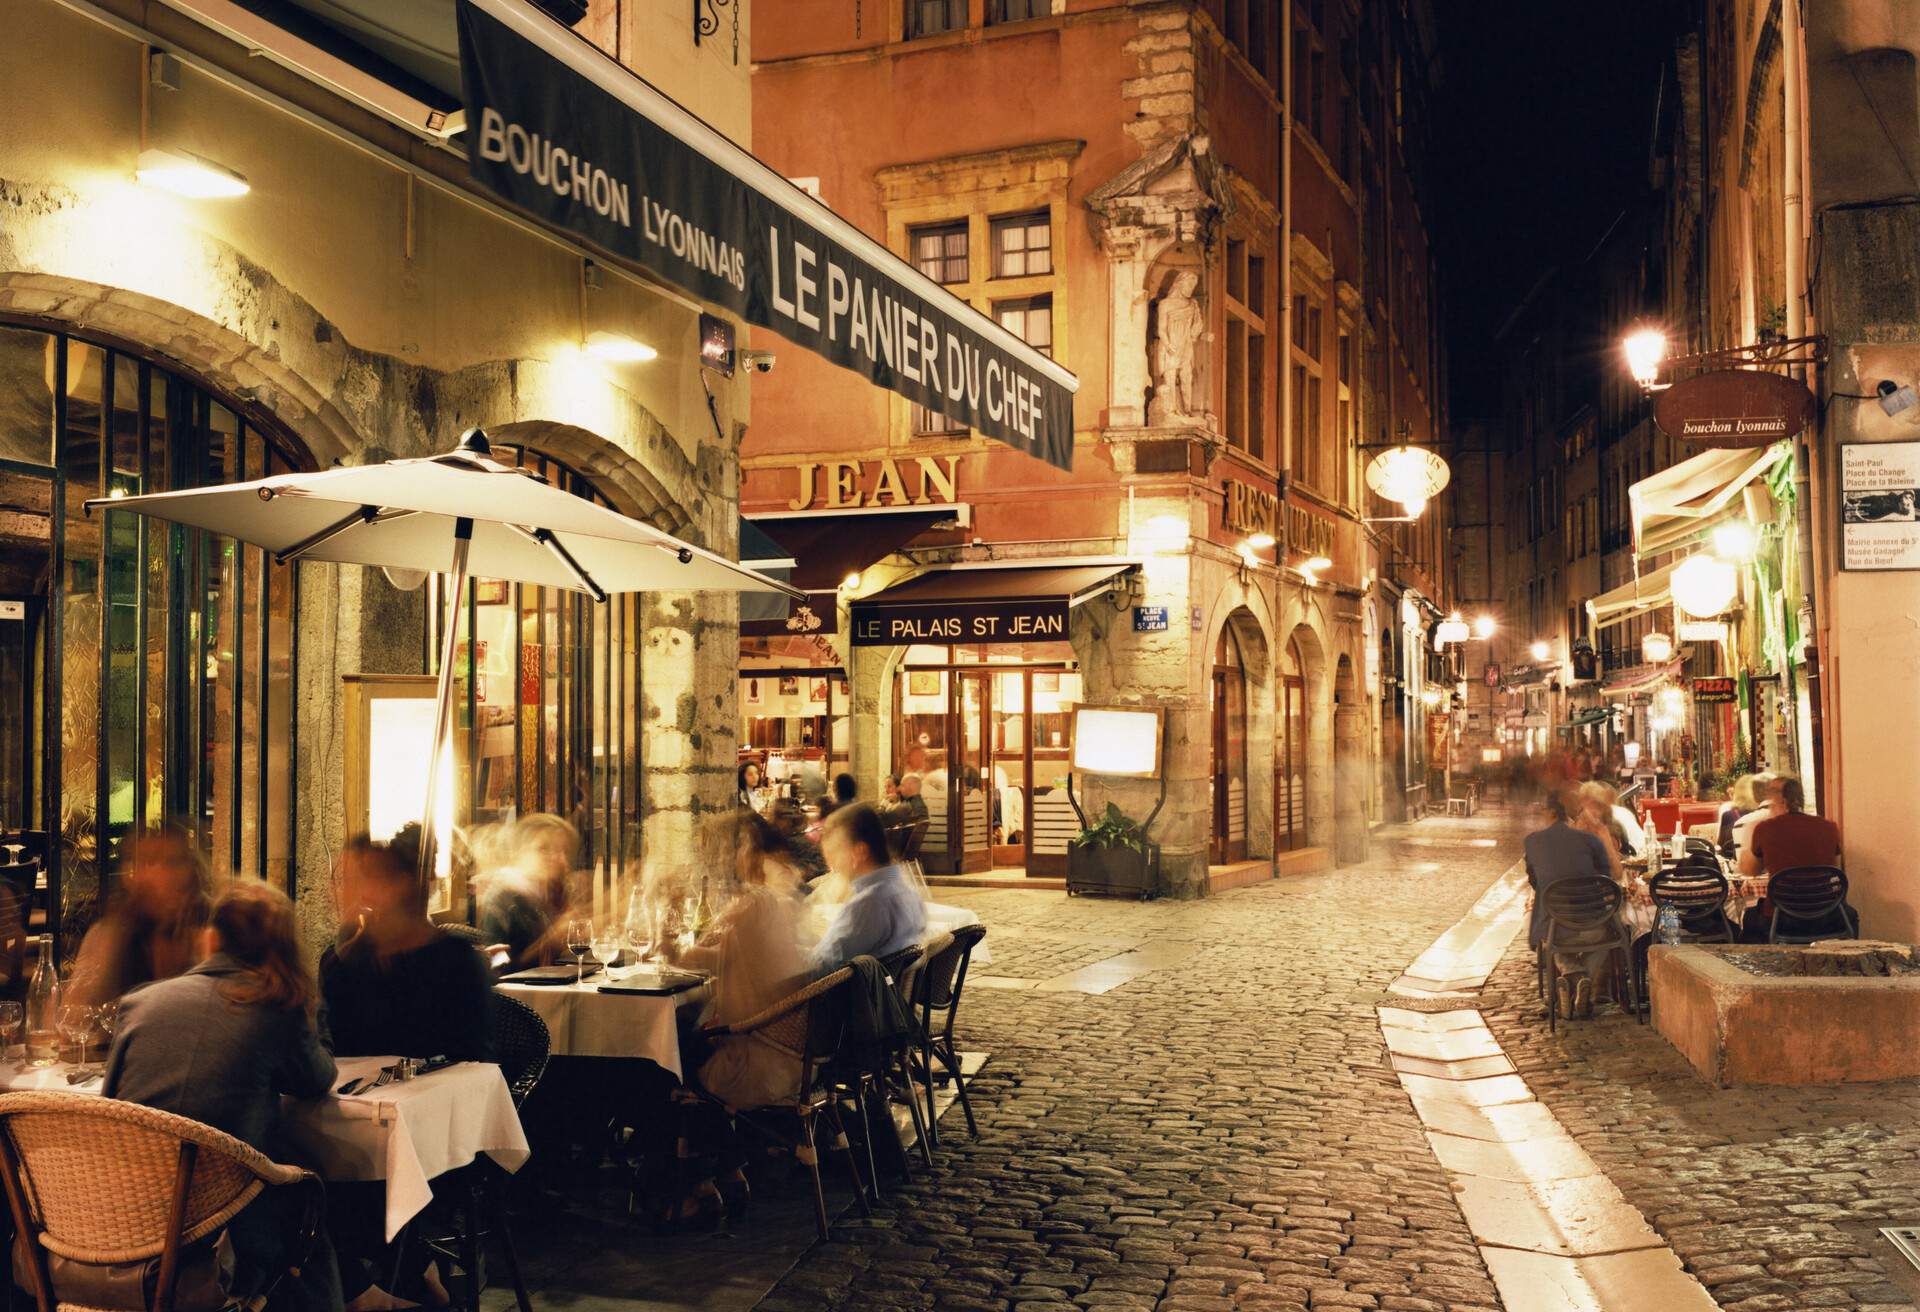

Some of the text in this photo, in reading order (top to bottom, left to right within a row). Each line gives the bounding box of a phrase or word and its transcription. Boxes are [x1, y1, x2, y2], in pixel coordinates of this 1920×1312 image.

[479, 106, 746, 292] BOUCHON LYONNAIS
[770, 225, 1042, 440] LE PANIER DU CHEF
[1683, 418, 1787, 434] bouchon lyonnais
[1866, 459, 1884, 467] Paul
[1878, 468, 1906, 477] Change
[787, 455, 961, 511] JEAN
[1887, 478, 1916, 486] Baleine
[1229, 478, 1336, 556] RESTAURANT
[857, 615, 1063, 638] LE PALAIS ST JEAN
[1146, 622, 1167, 630] JEAN
[1695, 679, 1732, 691] PIZZA
